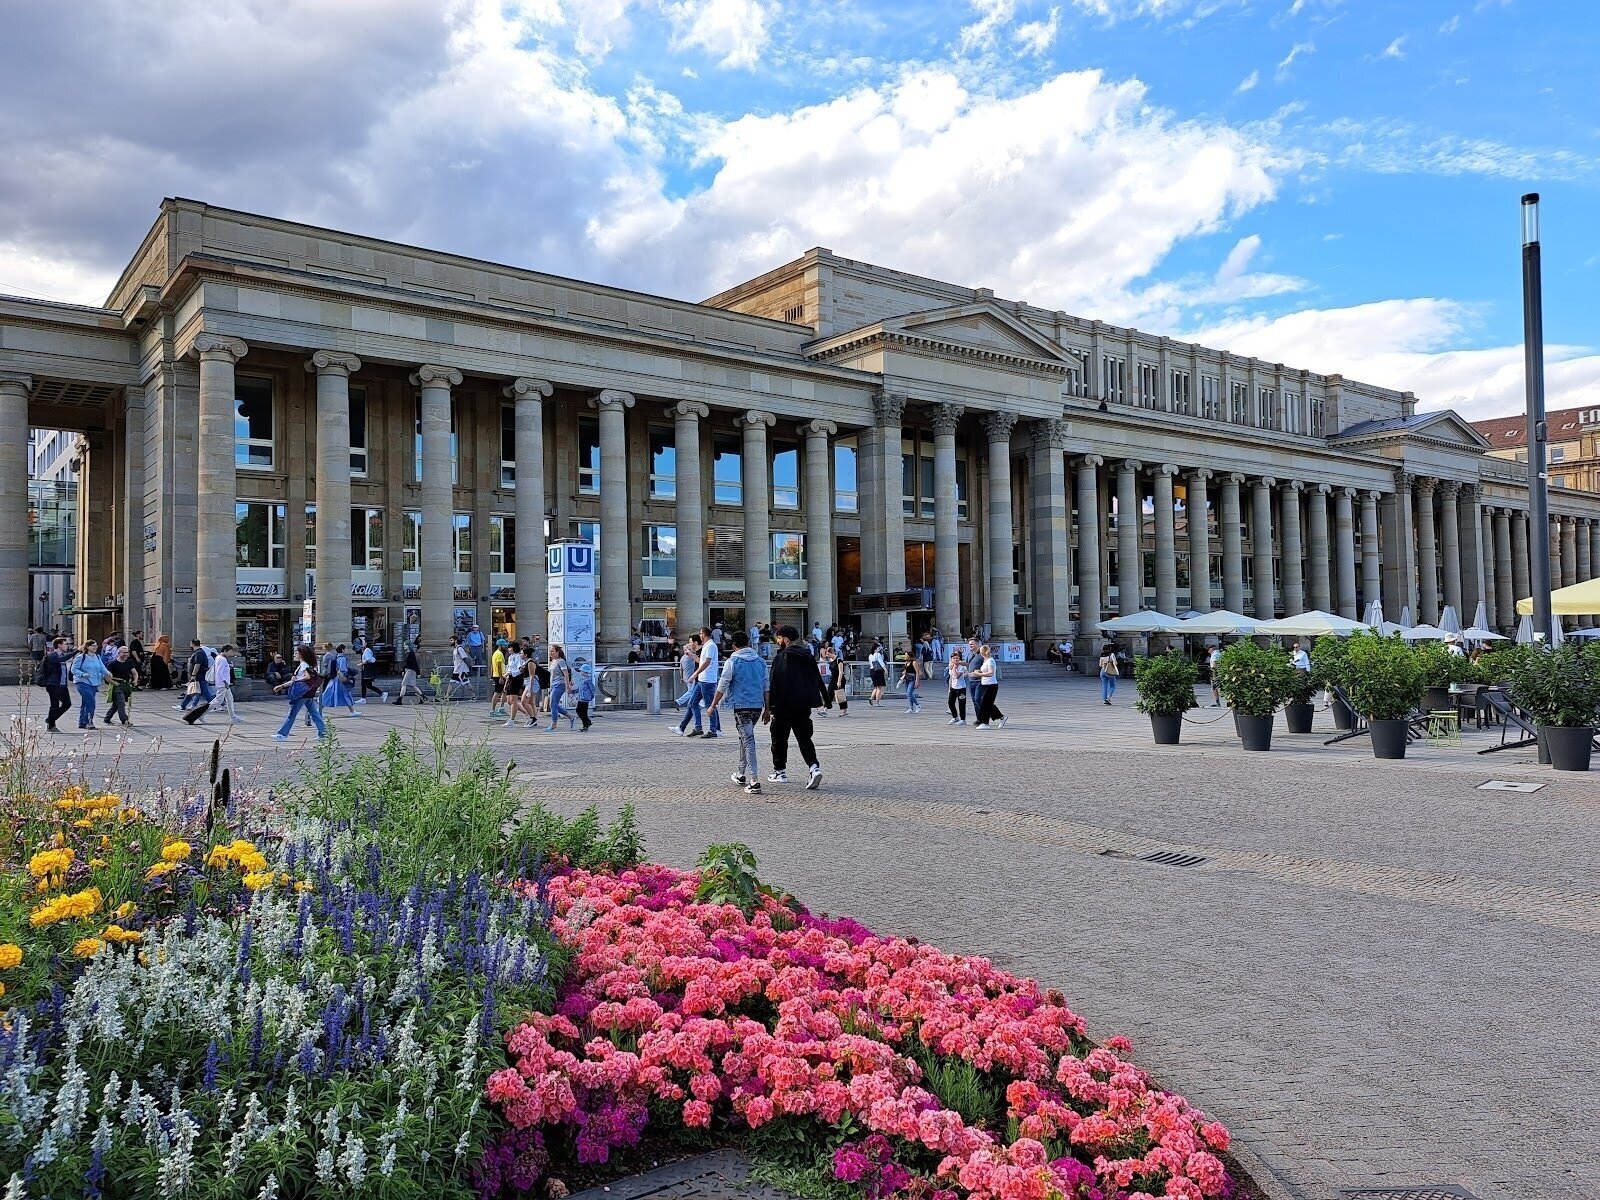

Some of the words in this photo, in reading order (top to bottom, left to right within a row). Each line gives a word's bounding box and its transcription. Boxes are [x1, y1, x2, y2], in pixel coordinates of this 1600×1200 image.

[551, 548, 560, 567] U
[571, 548, 588, 567] U
[236, 584, 277, 595] ouvenir
